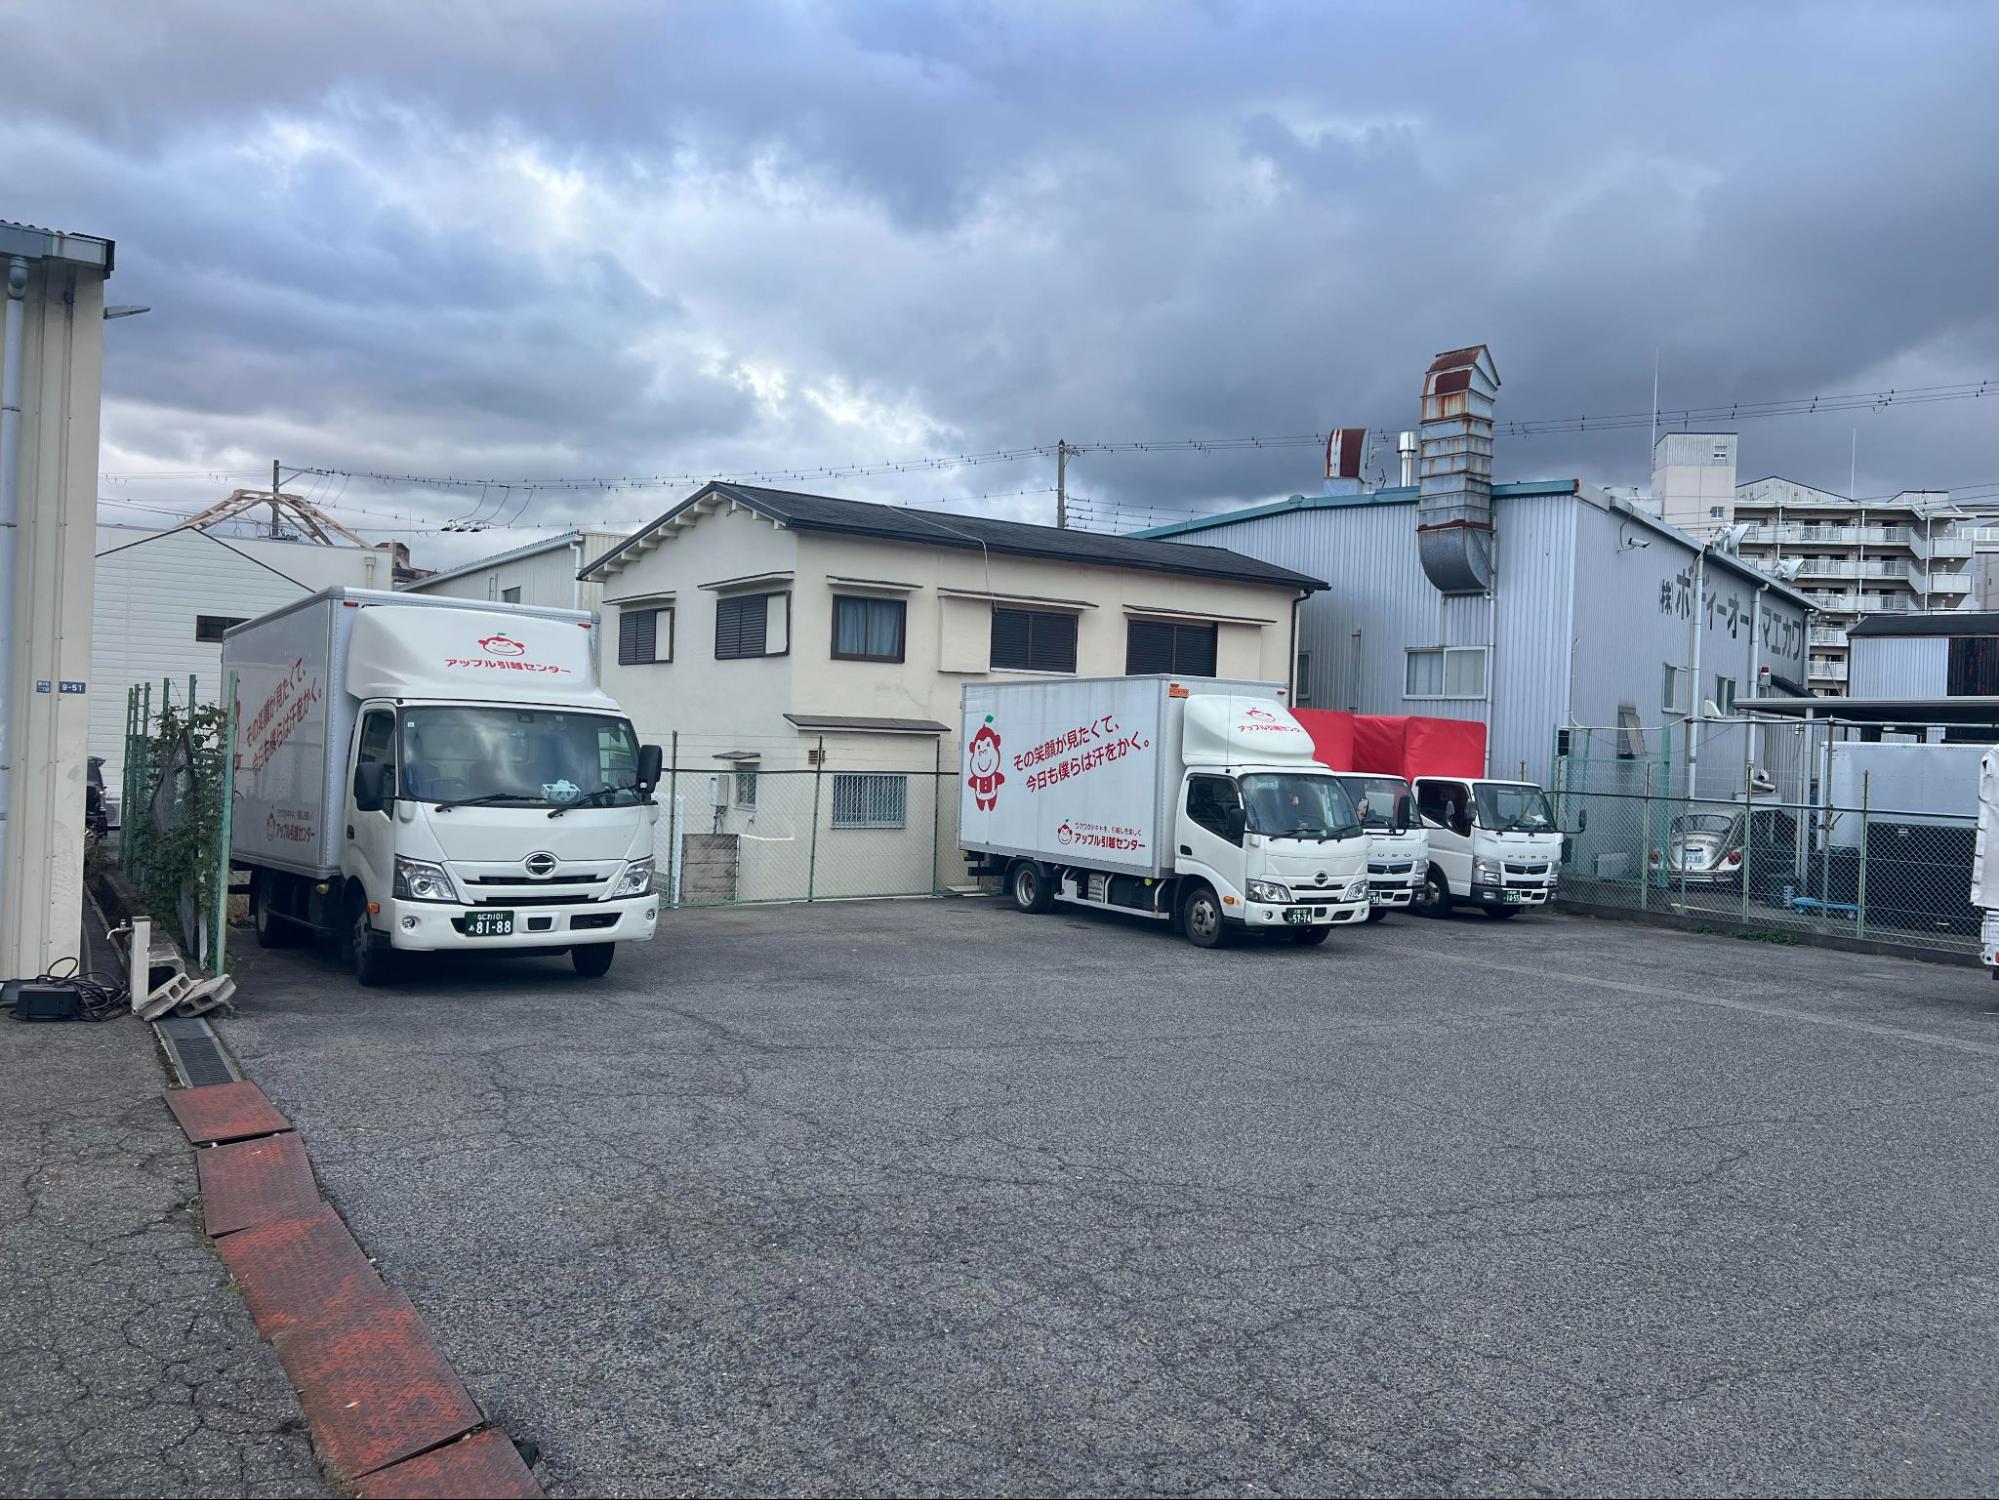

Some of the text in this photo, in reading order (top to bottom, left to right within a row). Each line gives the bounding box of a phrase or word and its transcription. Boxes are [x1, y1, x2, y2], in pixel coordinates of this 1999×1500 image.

[445, 659, 571, 673] アップル引越センター
[62, 684, 82, 692] 9-51
[1014, 715, 1119, 771] その笑顔が見たくて、
[1026, 731, 1149, 792] 今日も僕らは汗をかく。
[1075, 833, 1146, 850] アップル引越センター
[1292, 914, 1311, 924] 57-74
[476, 920, 511, 934] 81-88
